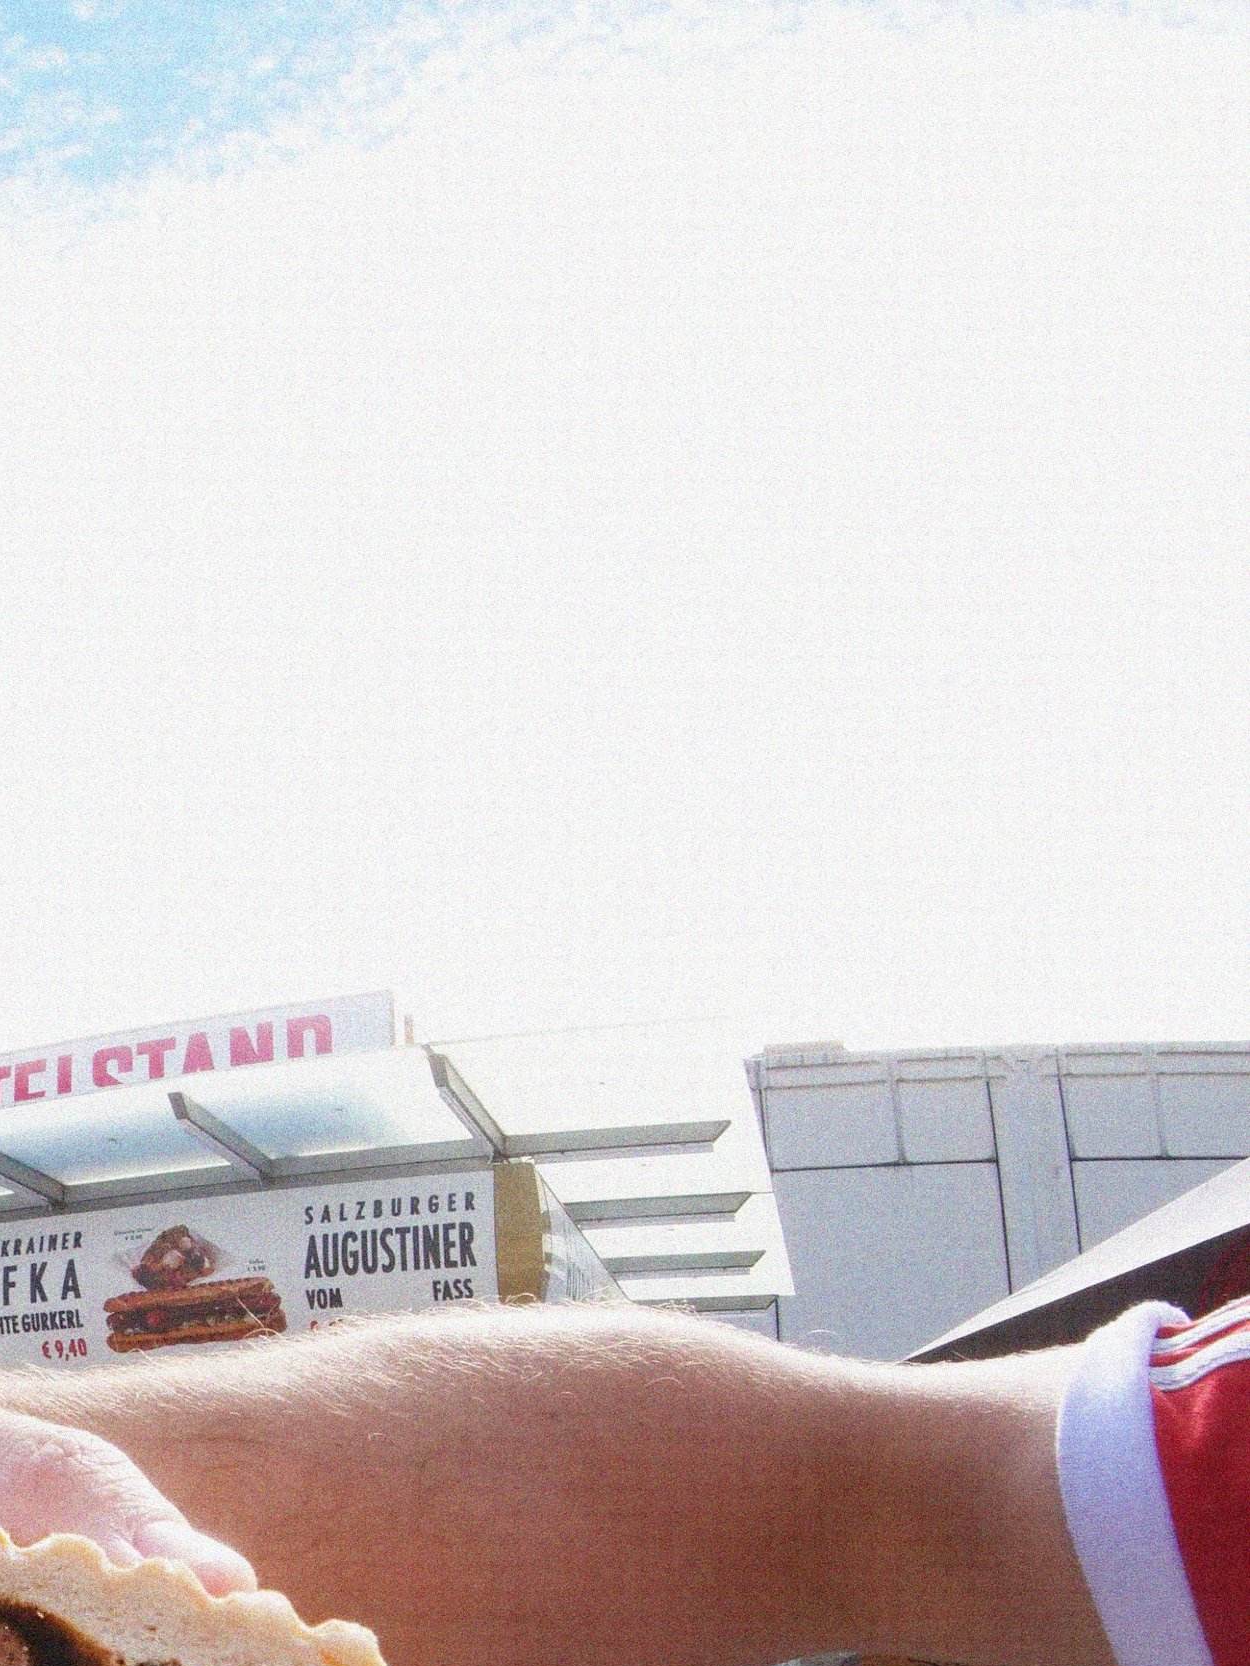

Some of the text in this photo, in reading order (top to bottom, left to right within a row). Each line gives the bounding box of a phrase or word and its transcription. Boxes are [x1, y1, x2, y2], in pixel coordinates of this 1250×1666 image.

[304, 1191, 476, 1225] SALZBURGER
[304, 1221, 478, 1279] AUGUSTINER
[305, 1278, 474, 1310] VOM FASS
[21, 1309, 84, 1333] GURKERL
